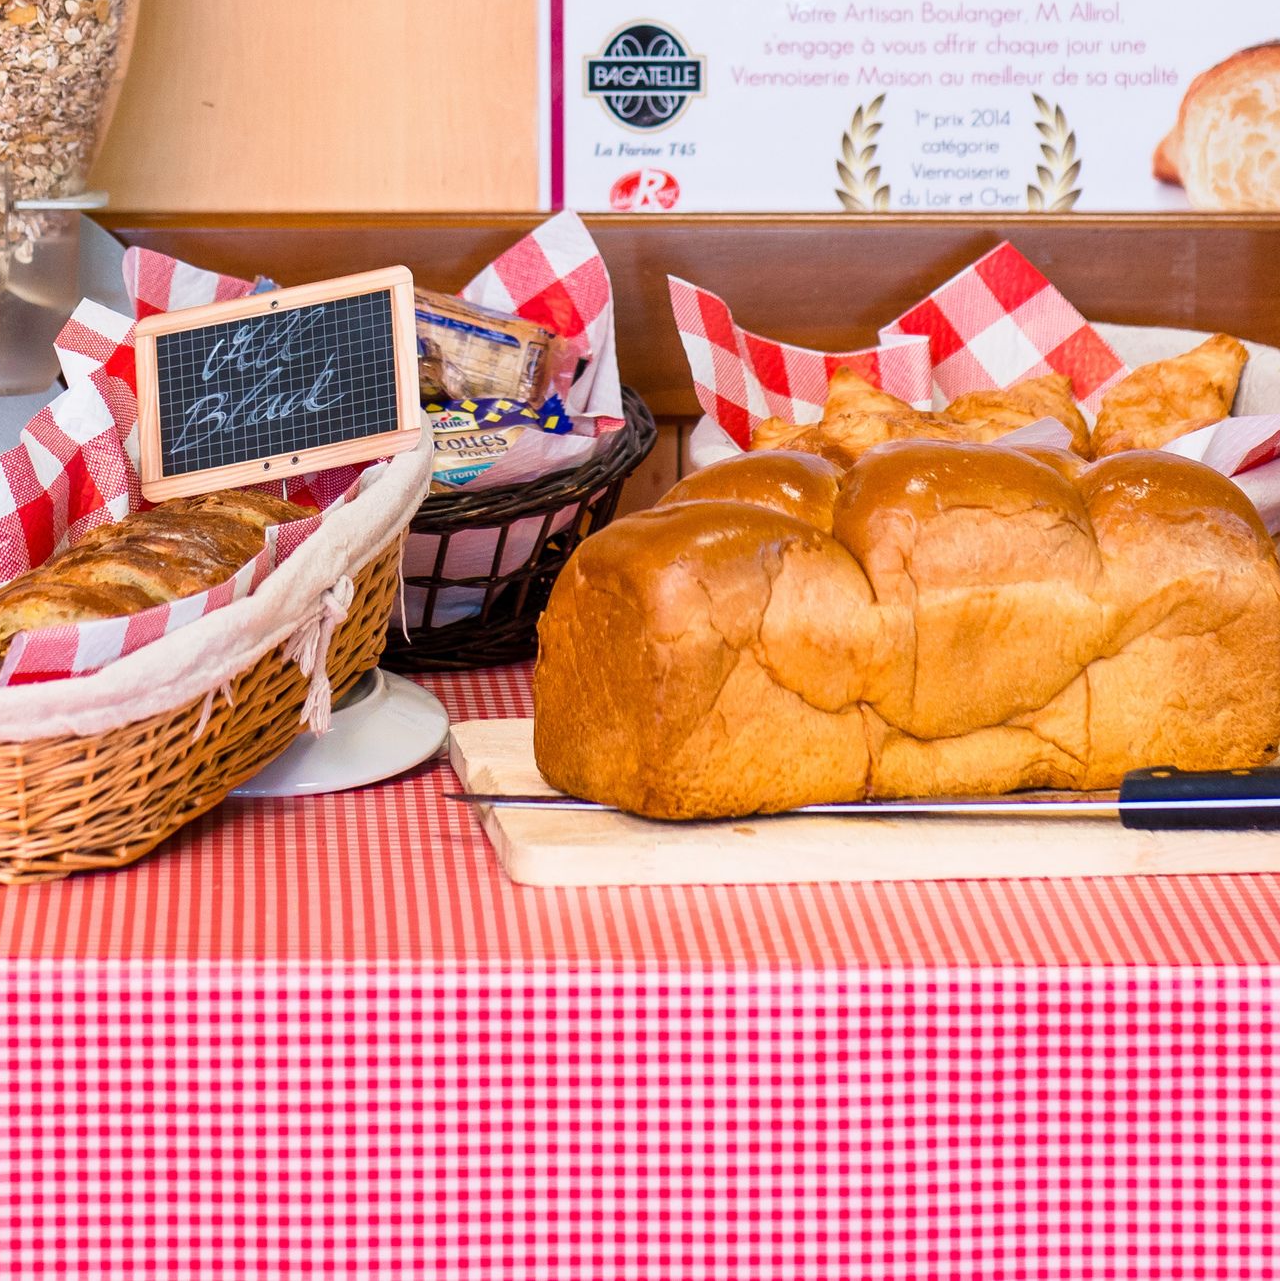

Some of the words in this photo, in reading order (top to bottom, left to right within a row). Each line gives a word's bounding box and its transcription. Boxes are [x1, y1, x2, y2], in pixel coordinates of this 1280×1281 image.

[786, 2, 837, 24] Votre
[844, 2, 914, 24] Artisan
[763, 34, 854, 61] s'engage
[861, 35, 875, 55] à
[883, 40, 926, 56] vous
[934, 33, 977, 55] offrir
[985, 33, 1059, 59] chaque
[1065, 35, 1103, 59] jour
[1111, 39, 1147, 56] une
[593, 65, 697, 87] BAGATELLE
[731, 65, 849, 87] Viennoiserie
[856, 65, 932, 87] Maison
[939, 71, 964, 87] au
[971, 64, 1044, 87] meilleur
[1052, 64, 1079, 86] de
[1086, 71, 1107, 86] sa
[1114, 64, 1179, 92] qualité
[934, 112, 964, 129] prix
[971, 109, 1011, 127] 2014
[594, 142, 613, 157] La
[619, 142, 664, 157] Farine
[668, 142, 697, 157] T45
[921, 138, 1000, 158] catégorie
[912, 162, 1011, 180] Viennoiserie
[899, 189, 920, 206] du
[926, 189, 952, 206] Loir
[959, 191, 973, 206] et
[980, 186, 1020, 206] Cher
